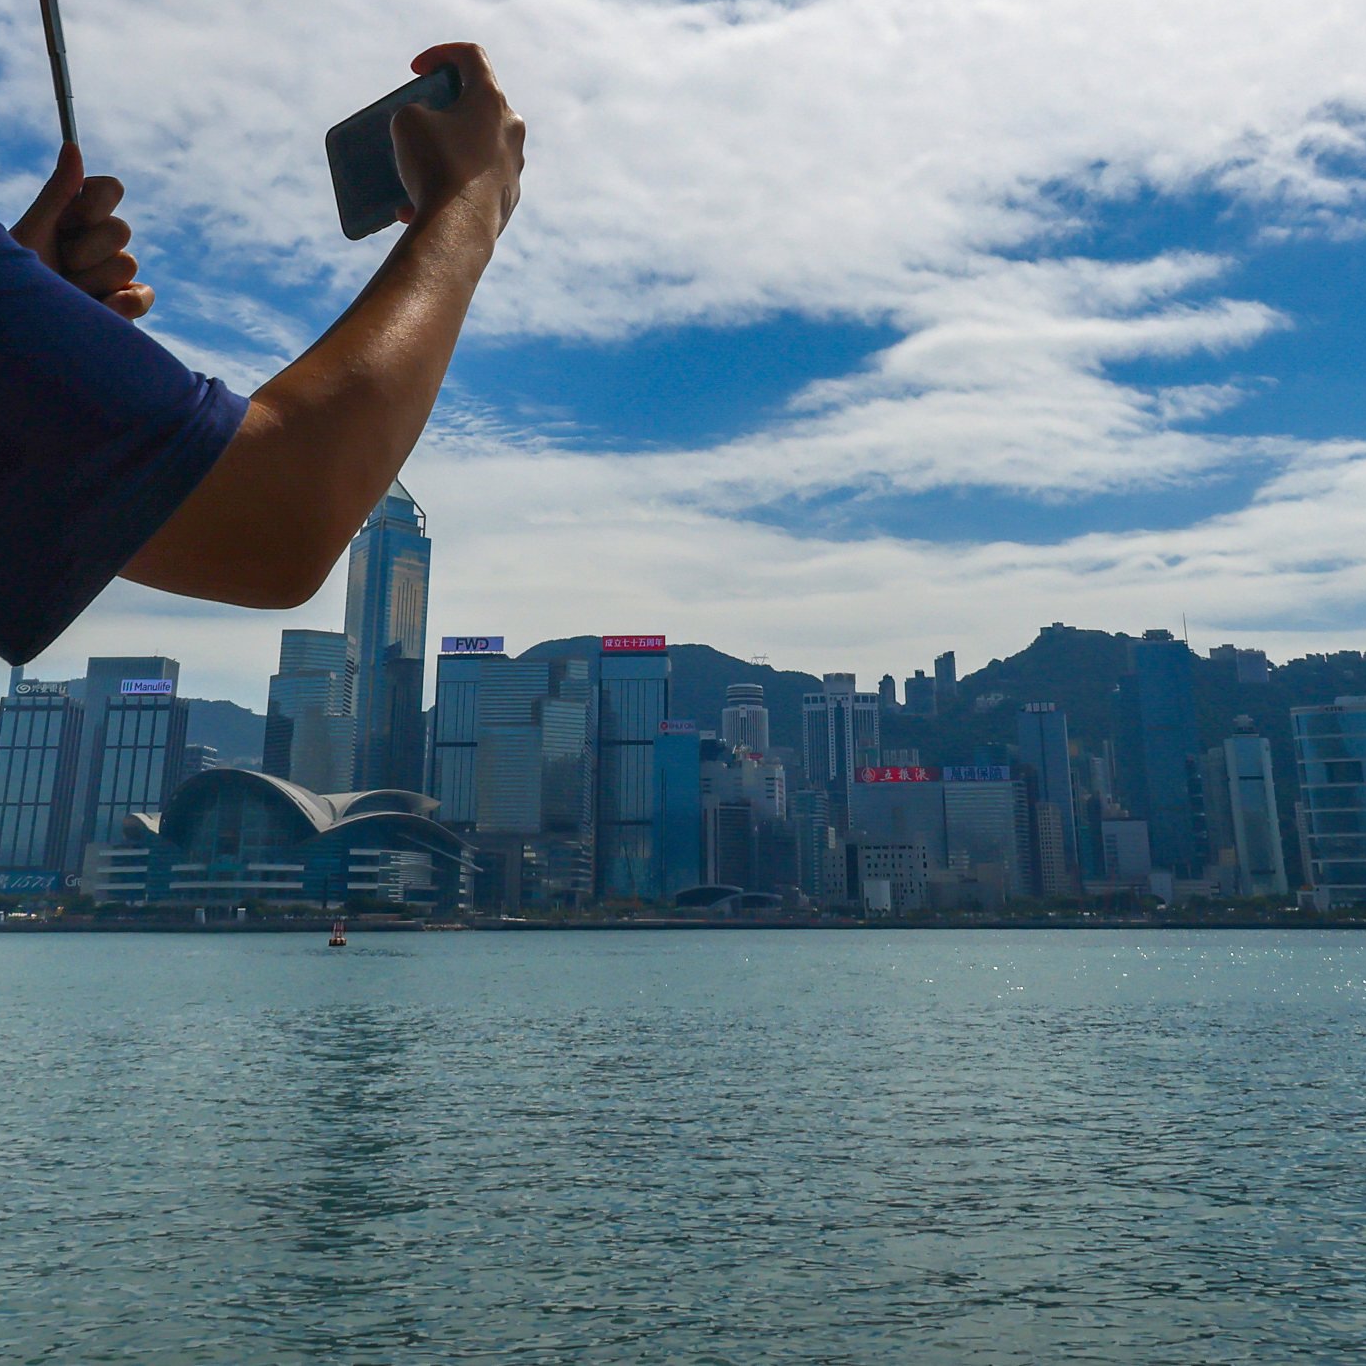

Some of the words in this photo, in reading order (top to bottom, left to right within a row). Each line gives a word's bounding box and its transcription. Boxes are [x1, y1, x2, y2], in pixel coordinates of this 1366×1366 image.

[456, 637, 489, 650] FWD
[605, 637, 663, 648] 成立七十五周年
[134, 681, 171, 692] Manulife
